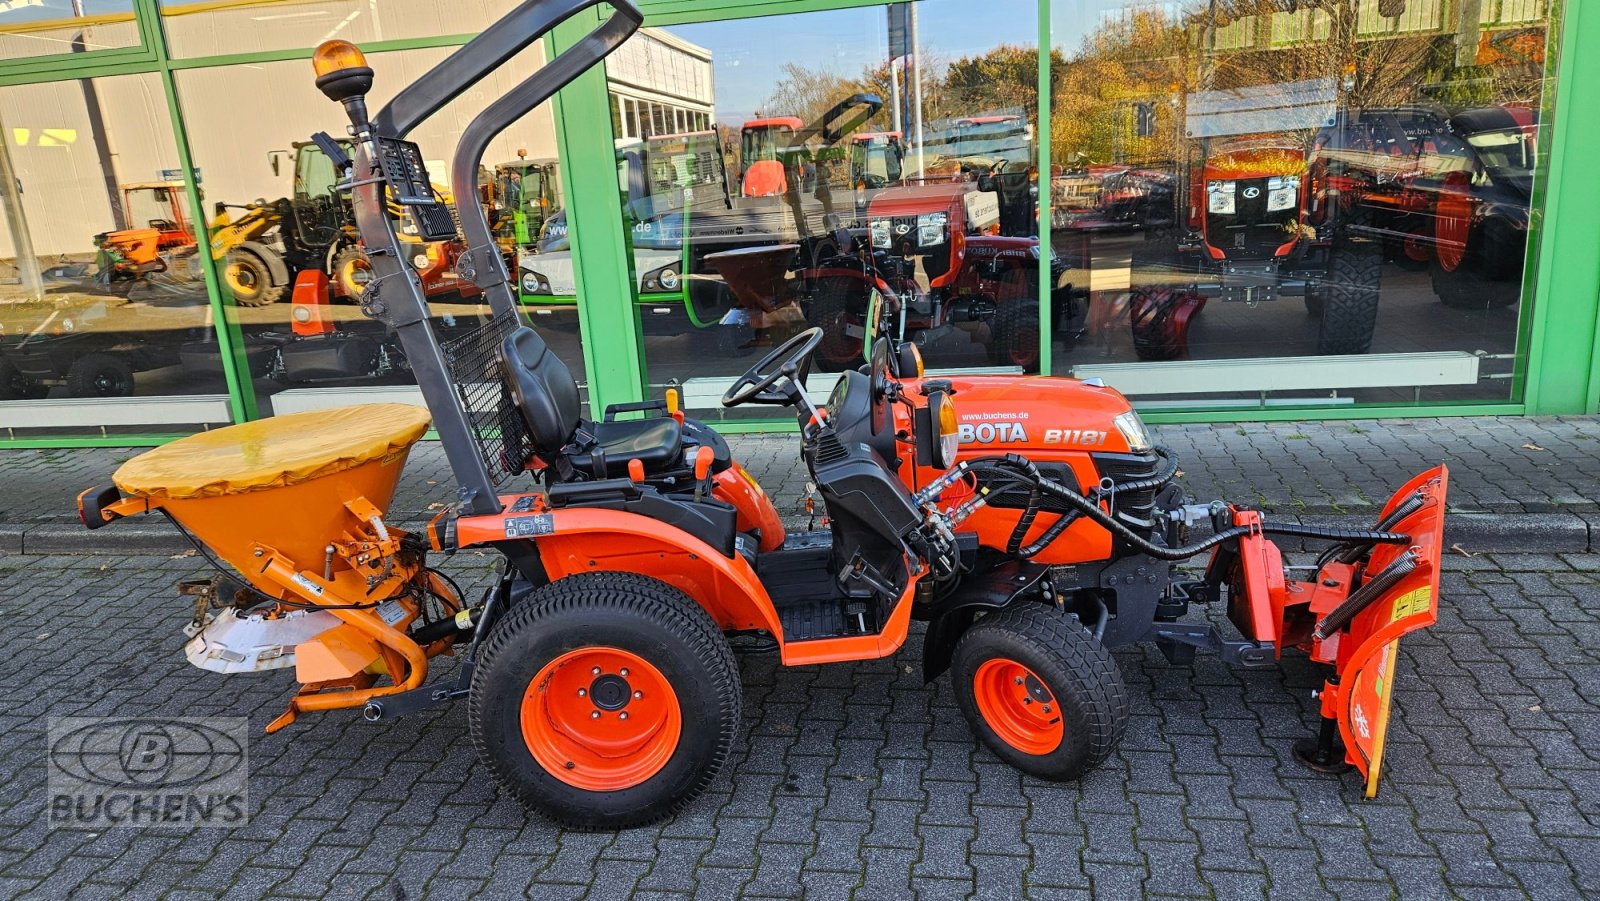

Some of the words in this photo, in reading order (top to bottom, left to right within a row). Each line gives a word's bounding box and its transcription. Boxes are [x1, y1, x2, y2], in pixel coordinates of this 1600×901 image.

[961, 411, 1029, 421] www.buchens.de
[958, 422, 1029, 444] BOTA
[1043, 429, 1108, 446] B1181
